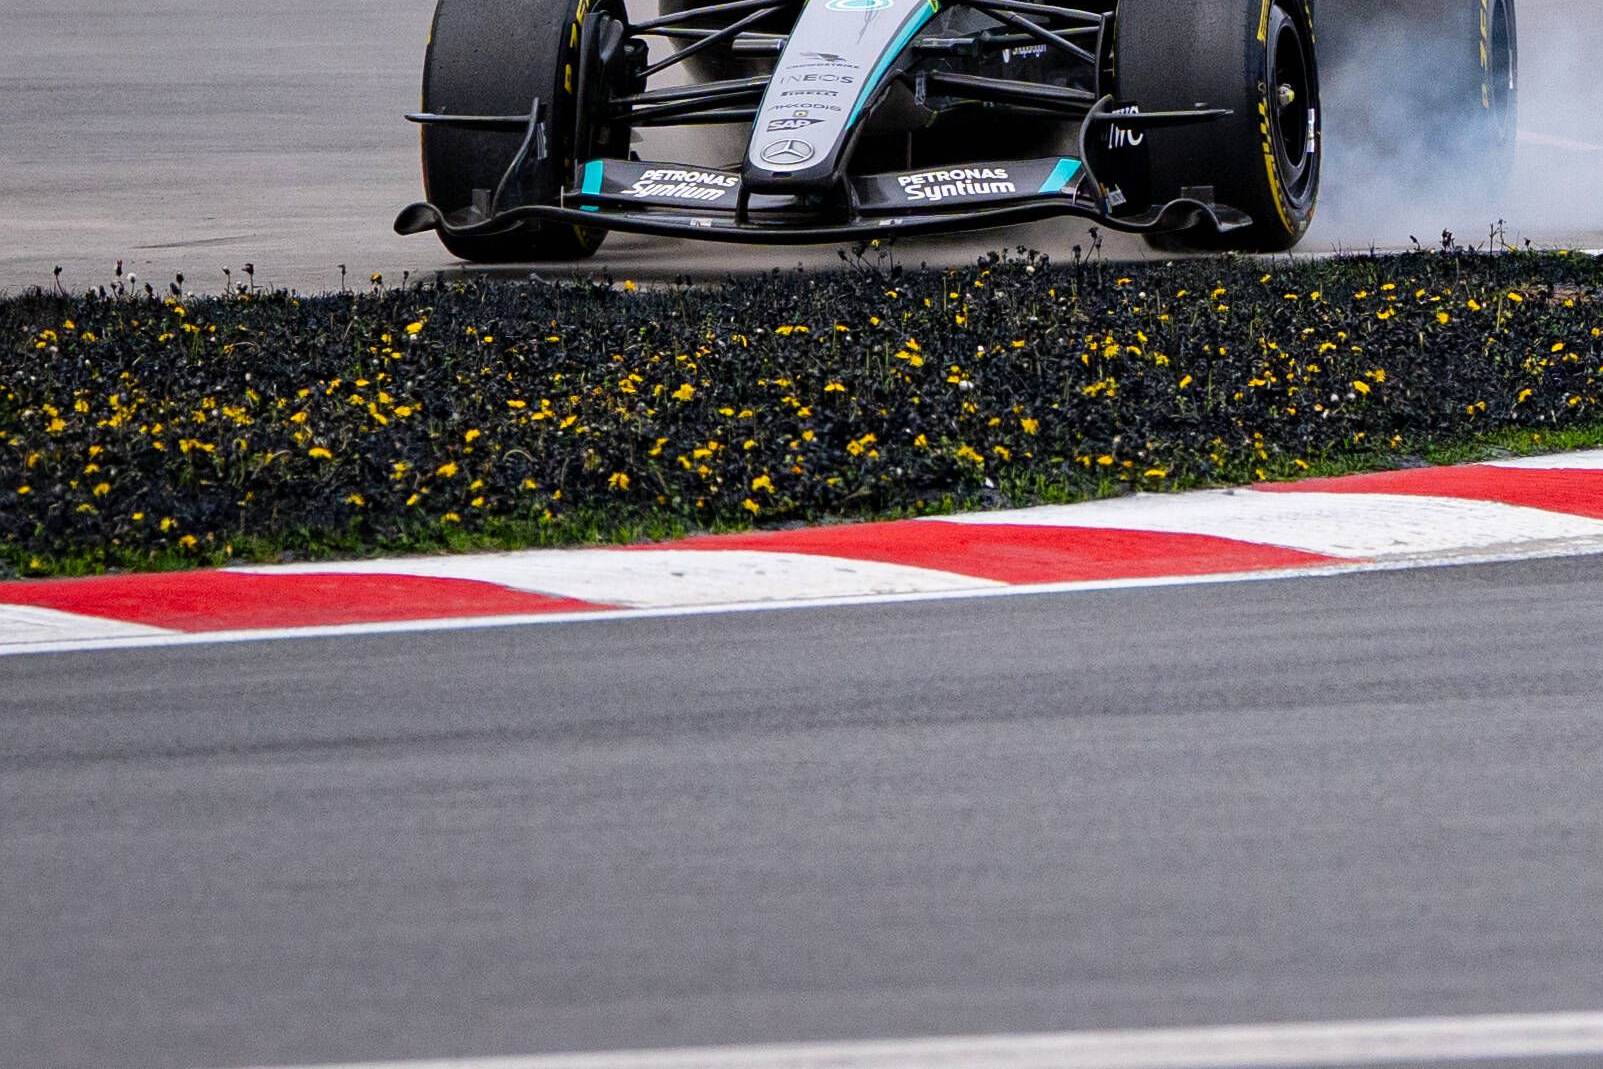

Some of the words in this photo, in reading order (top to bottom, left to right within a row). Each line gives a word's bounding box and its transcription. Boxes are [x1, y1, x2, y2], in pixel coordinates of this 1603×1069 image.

[780, 74, 855, 85] INEOS
[768, 119, 811, 130] SAP
[640, 169, 739, 188] PETRONAS
[897, 168, 1009, 187] PETRONAS
[620, 180, 726, 201] Syntium
[904, 179, 1016, 201] Syntium
